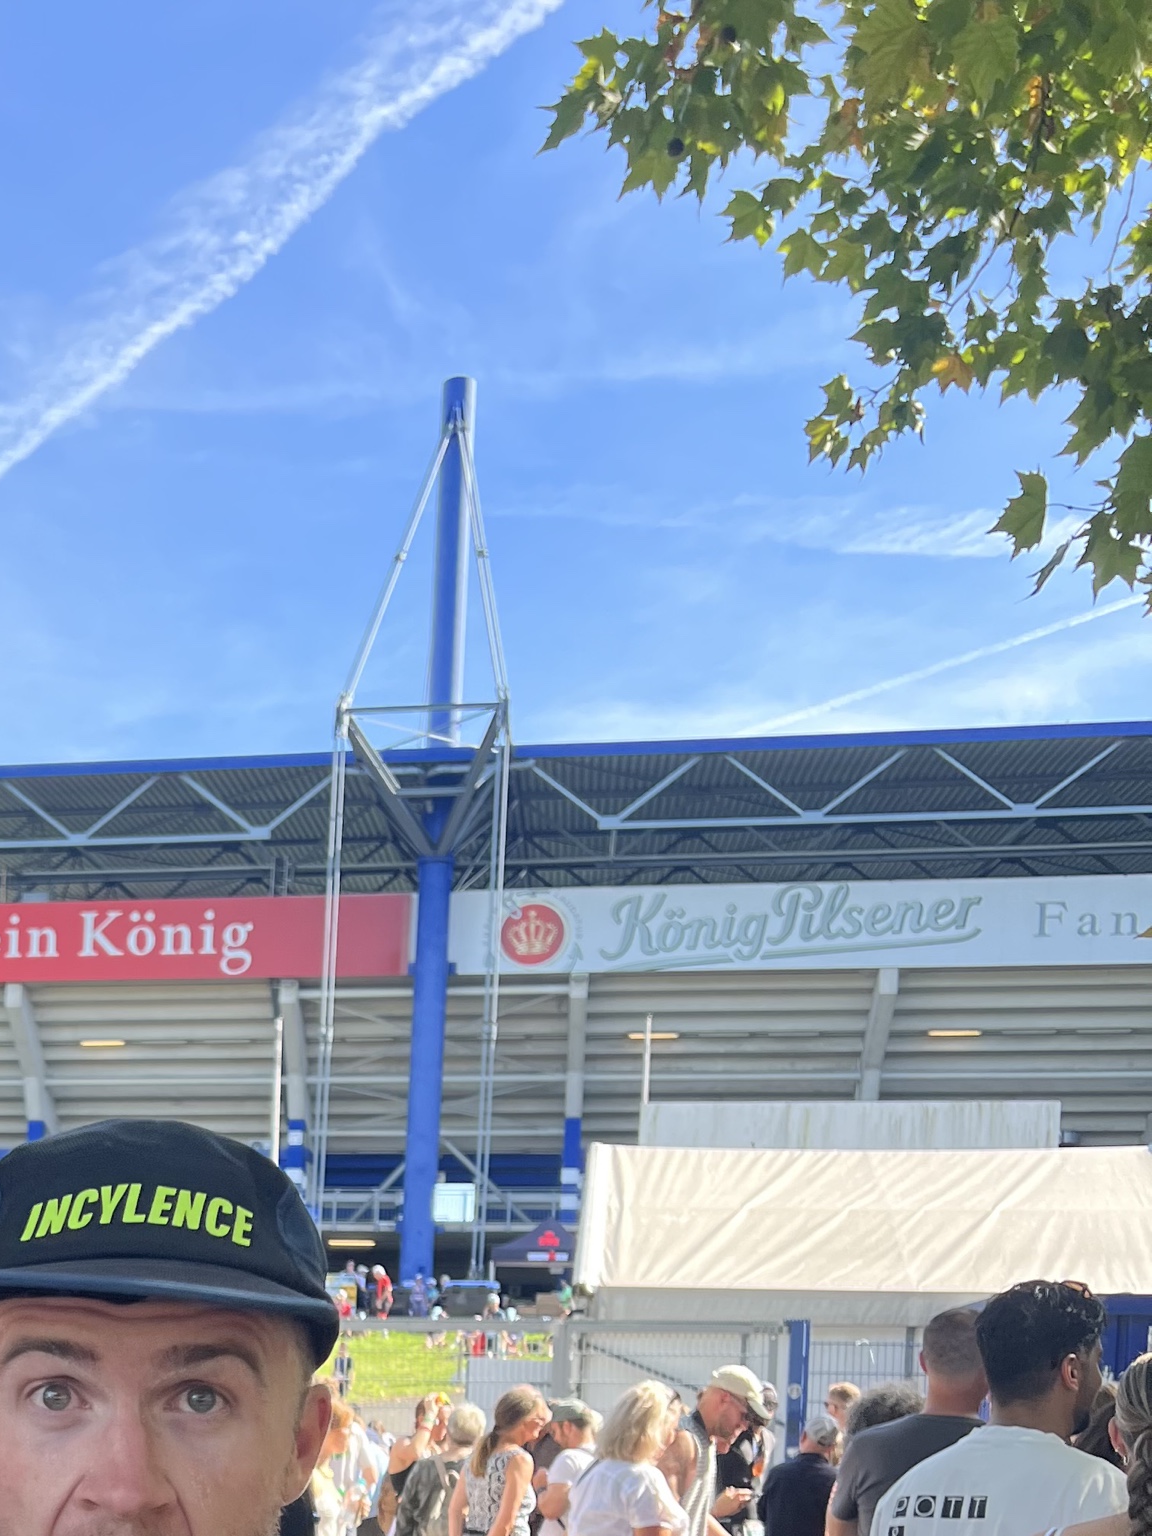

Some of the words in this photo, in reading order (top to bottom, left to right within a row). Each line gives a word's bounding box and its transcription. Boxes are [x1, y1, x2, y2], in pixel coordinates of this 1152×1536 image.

[78, 908, 255, 975] König
[600, 891, 768, 960] König
[766, 882, 983, 945] Pilsener
[1033, 901, 1138, 937] Fan
[20, 1182, 255, 1248] INCYLENCE
[893, 1495, 988, 1519] POTT
